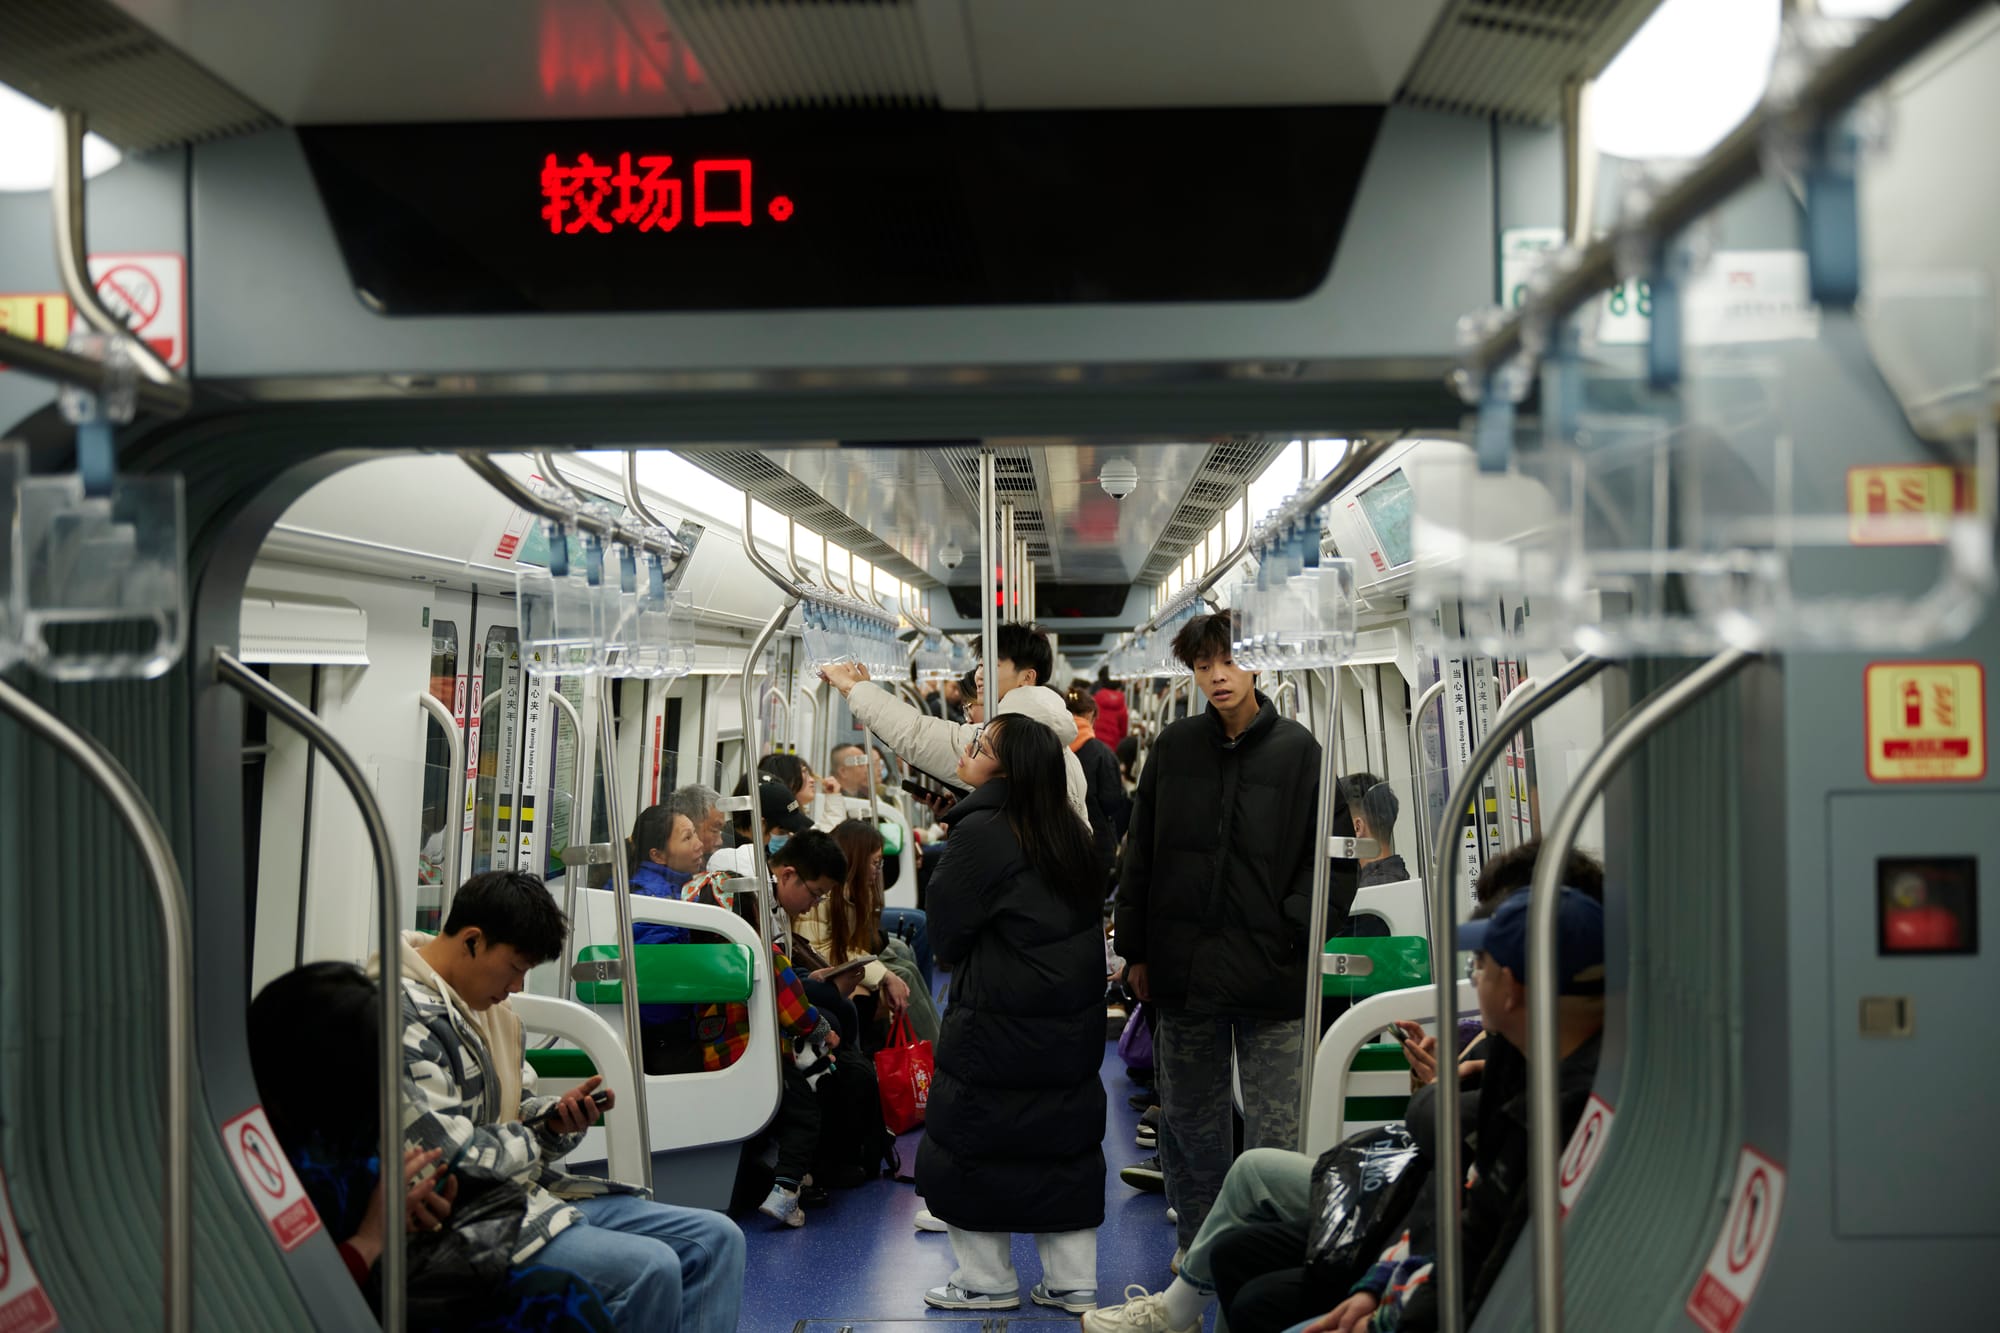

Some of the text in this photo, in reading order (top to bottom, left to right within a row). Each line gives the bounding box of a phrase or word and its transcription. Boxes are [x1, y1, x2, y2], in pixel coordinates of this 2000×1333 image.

[541, 152, 795, 235] 较场口。
[529, 677, 540, 723] 当心夹手
[1453, 668, 1464, 715] 当心夹手
[529, 727, 537, 749] Warning
